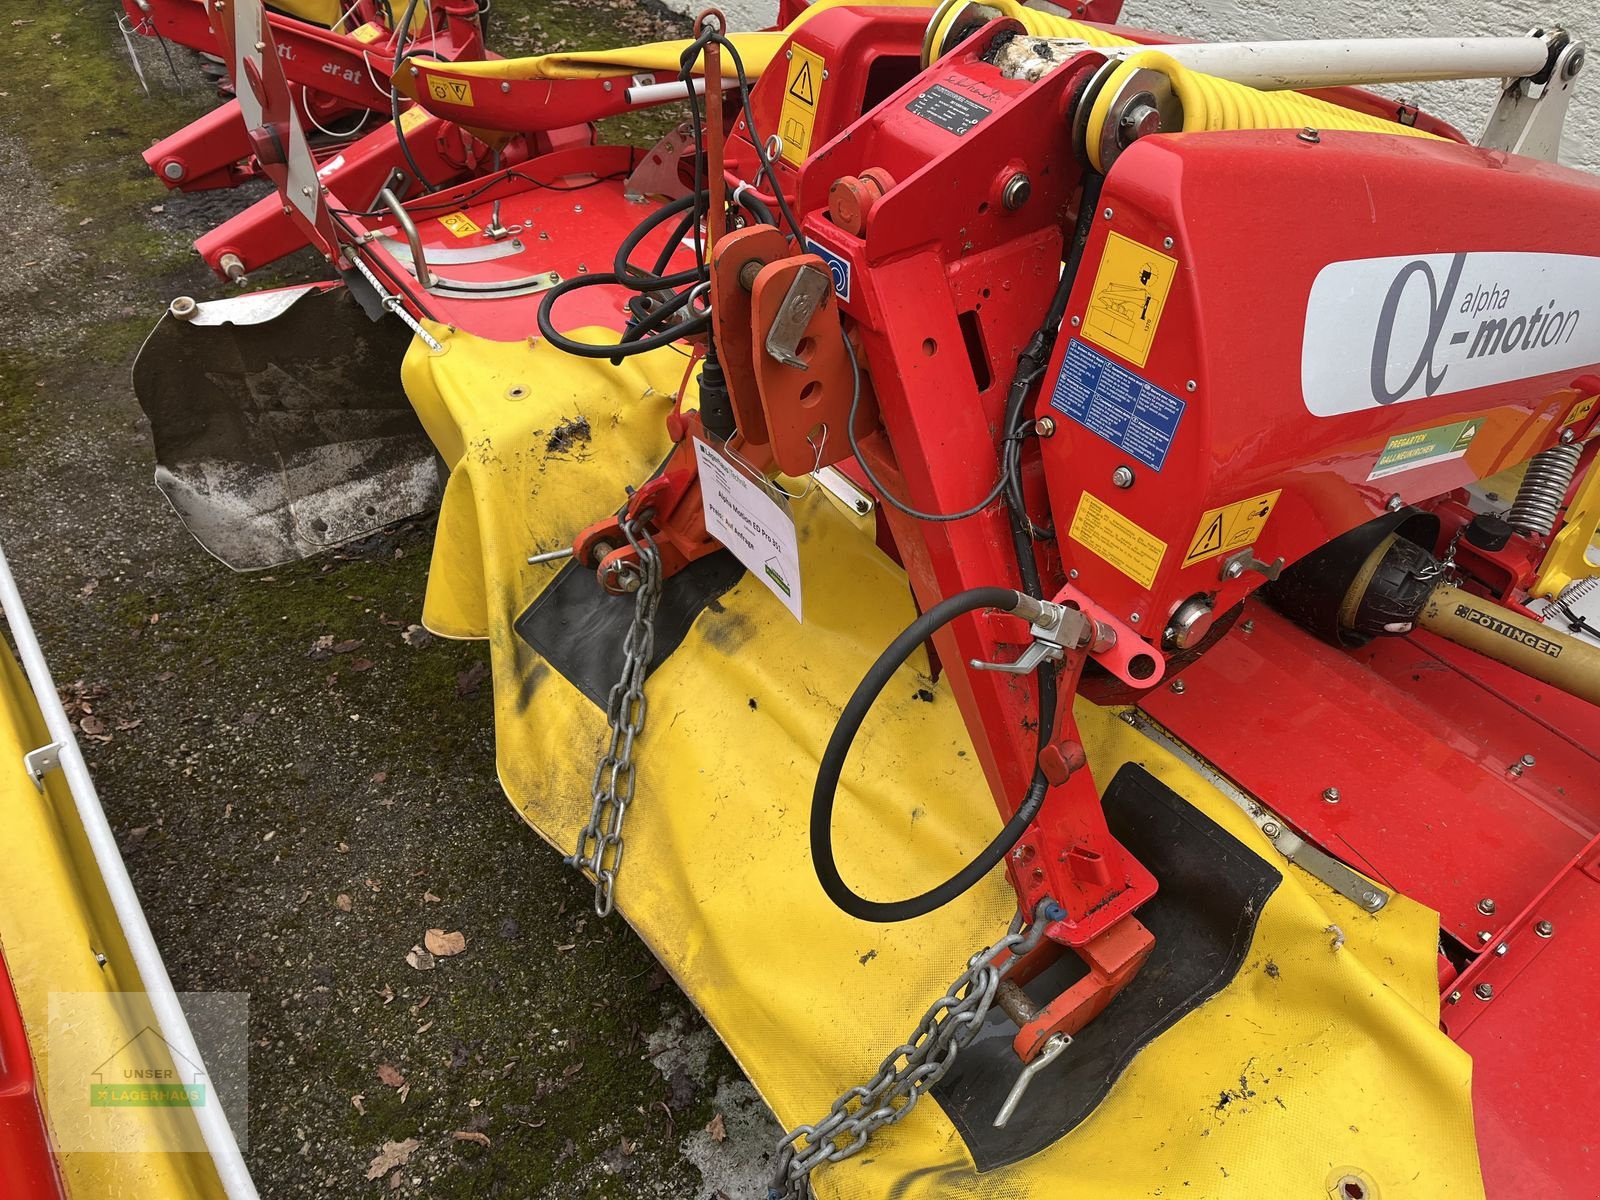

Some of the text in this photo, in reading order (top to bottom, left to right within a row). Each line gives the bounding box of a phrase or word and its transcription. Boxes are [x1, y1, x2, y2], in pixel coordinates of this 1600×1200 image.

[1460, 283, 1510, 318] alpha
[718, 490, 732, 509] Alpha
[732, 504, 752, 526] Motion
[761, 528, 772, 543] Pro
[734, 527, 755, 550] Anfrage
[1468, 611, 1561, 657] PÖTTINGER
